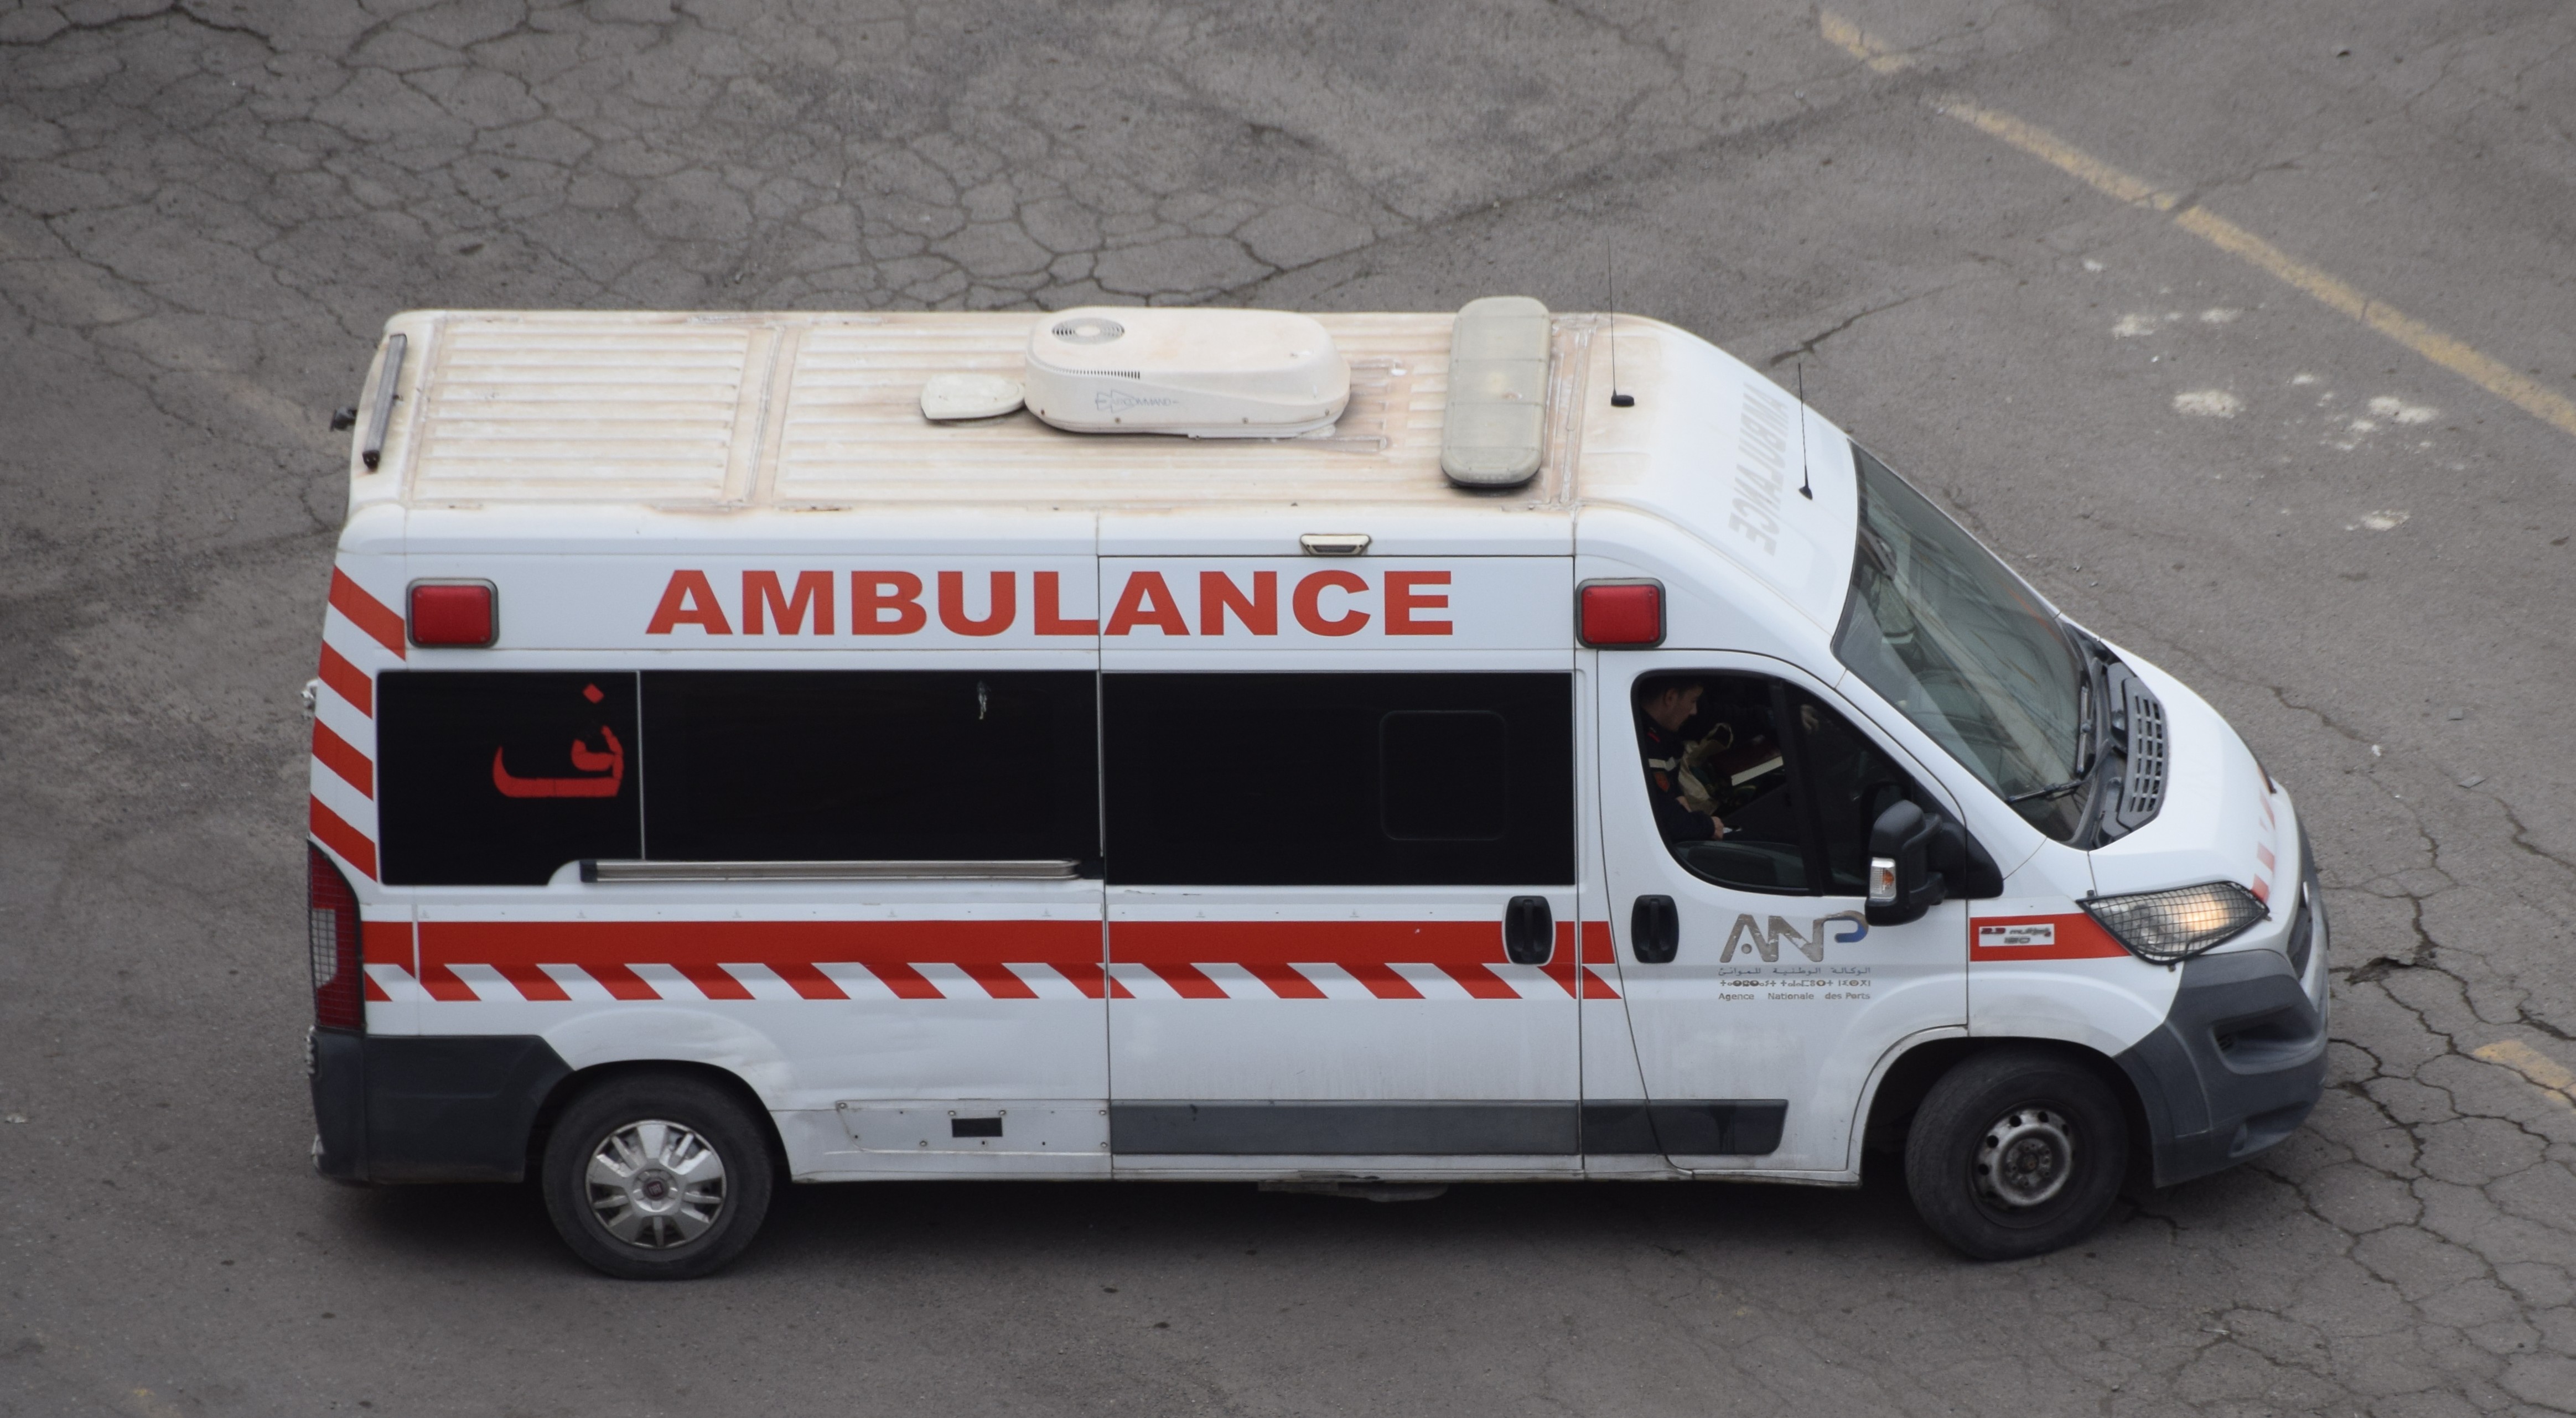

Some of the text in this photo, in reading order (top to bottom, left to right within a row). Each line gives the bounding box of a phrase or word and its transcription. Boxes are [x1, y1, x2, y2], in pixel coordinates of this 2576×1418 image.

[645, 569, 1454, 637] AMBULANCE
[1719, 910, 1869, 963] ANP
[1772, 967, 1821, 977] الوطنية
[1829, 967, 1870, 976] الوكالة
[1718, 993, 1755, 1001] Agence
[1768, 992, 1815, 1000] Nationale
[1845, 992, 1871, 1000] Ports
